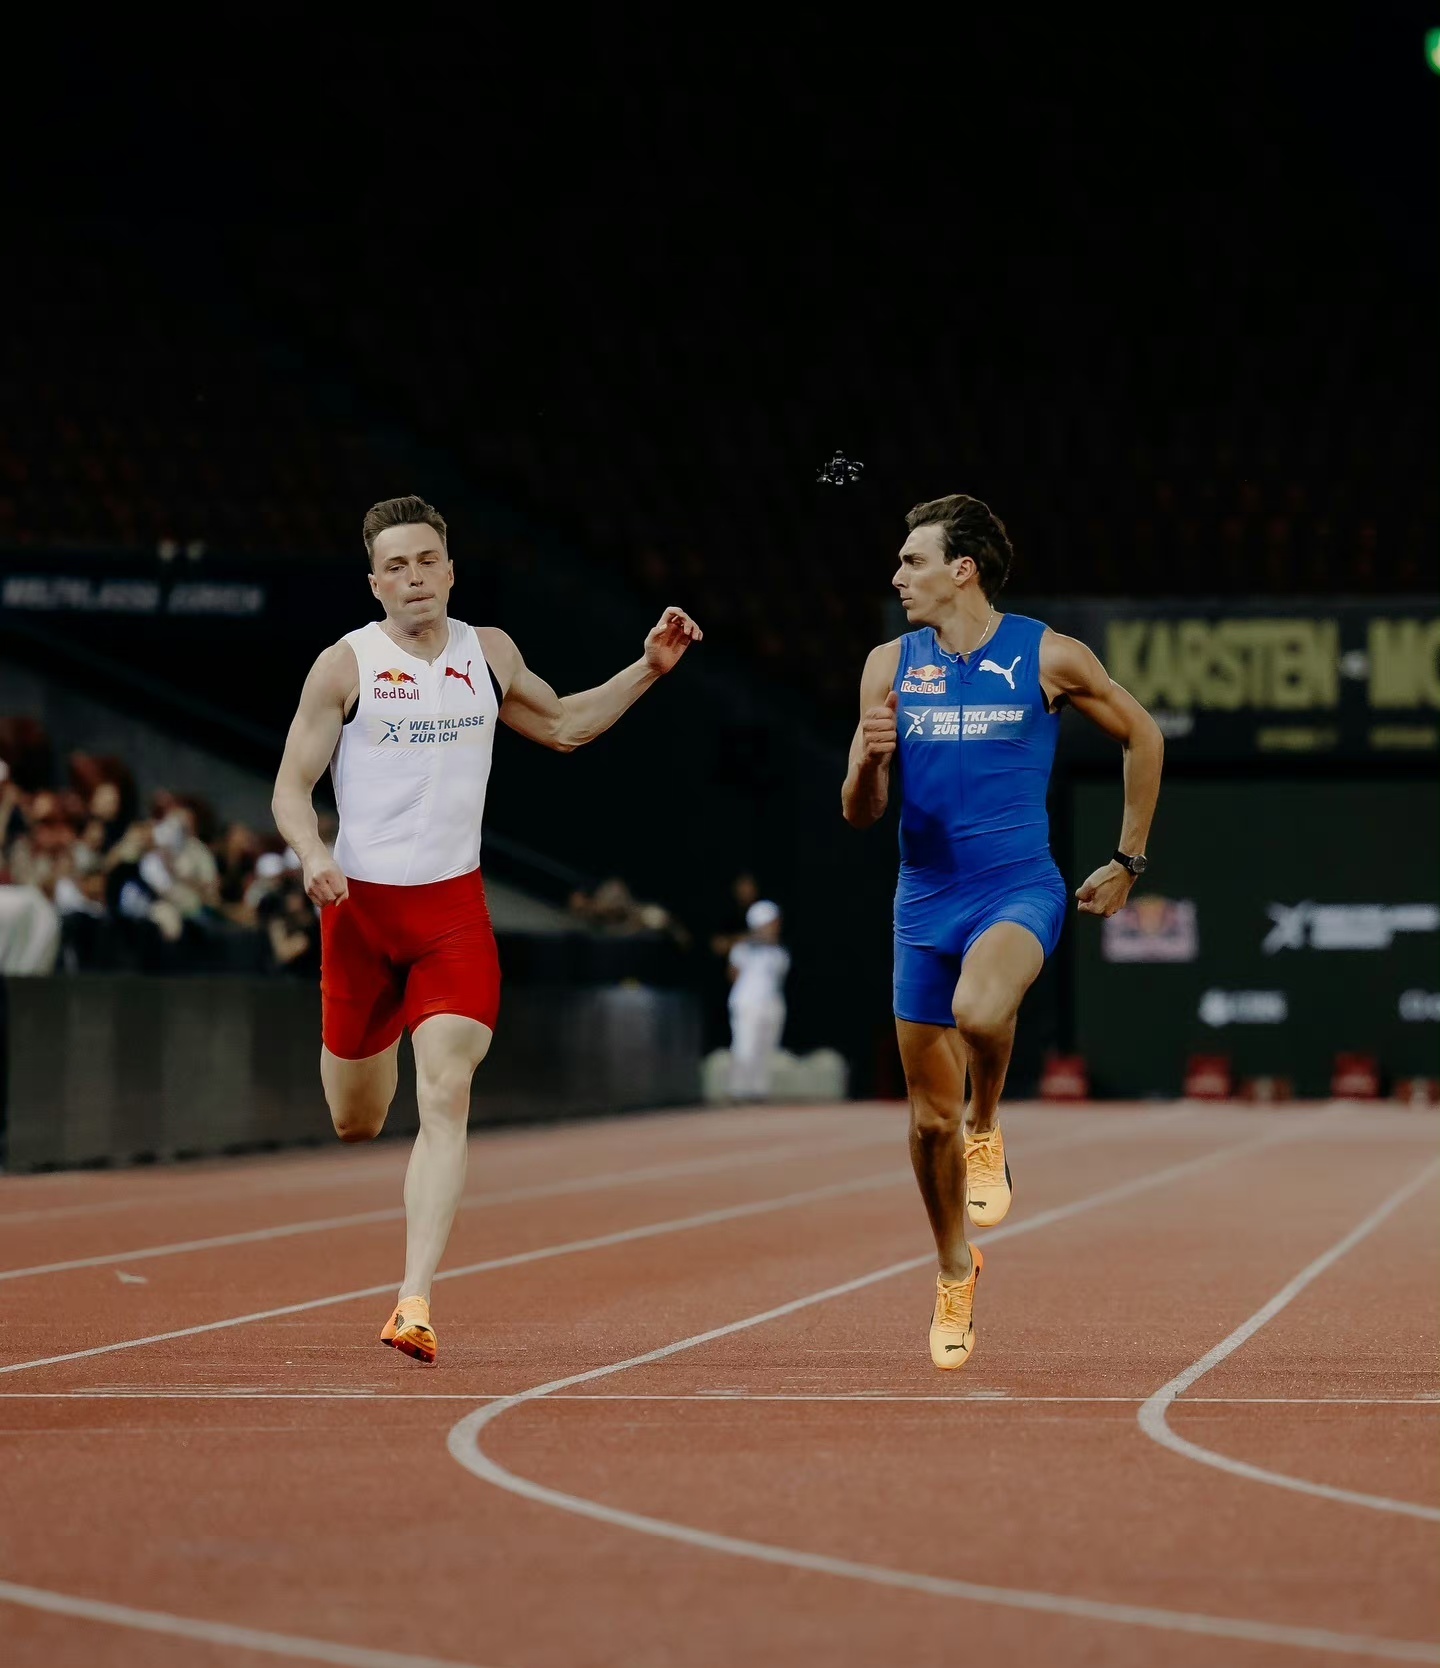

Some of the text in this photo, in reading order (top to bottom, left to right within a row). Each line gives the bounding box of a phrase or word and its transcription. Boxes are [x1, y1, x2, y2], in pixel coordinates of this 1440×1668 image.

[1106, 617, 1339, 711] KARSTEN
[373, 687, 420, 700] Red Bull
[901, 680, 946, 694] Red Bull
[932, 710, 1024, 722] WELTKLASSE
[409, 715, 485, 731] WELTKLASSE
[932, 722, 988, 735] ZÜRICH
[409, 731, 458, 743] ZÜRICH
